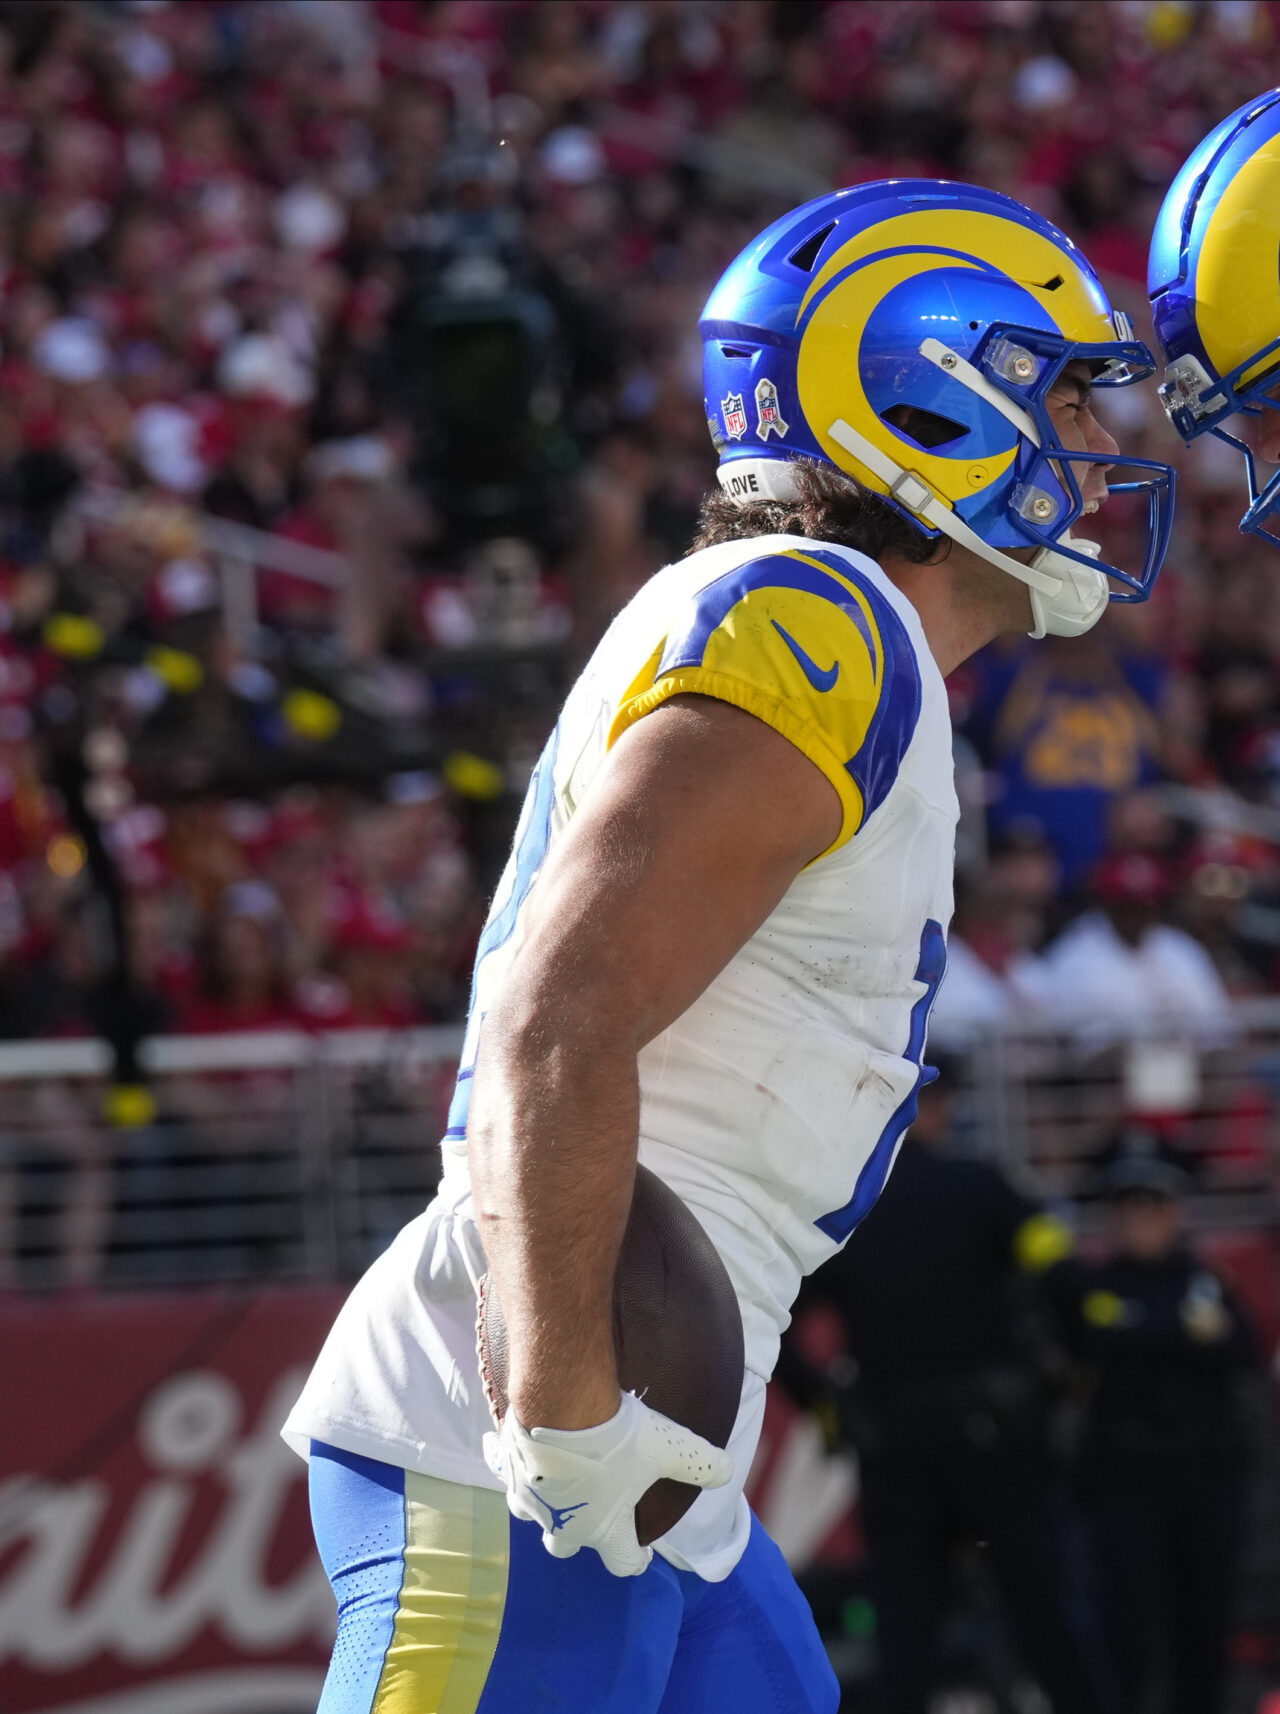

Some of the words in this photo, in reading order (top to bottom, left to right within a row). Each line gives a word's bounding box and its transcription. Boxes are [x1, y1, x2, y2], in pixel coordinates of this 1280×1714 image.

[727, 412, 744, 432] NFL
[761, 408, 777, 421] NFL
[726, 474, 760, 499] LOVE
